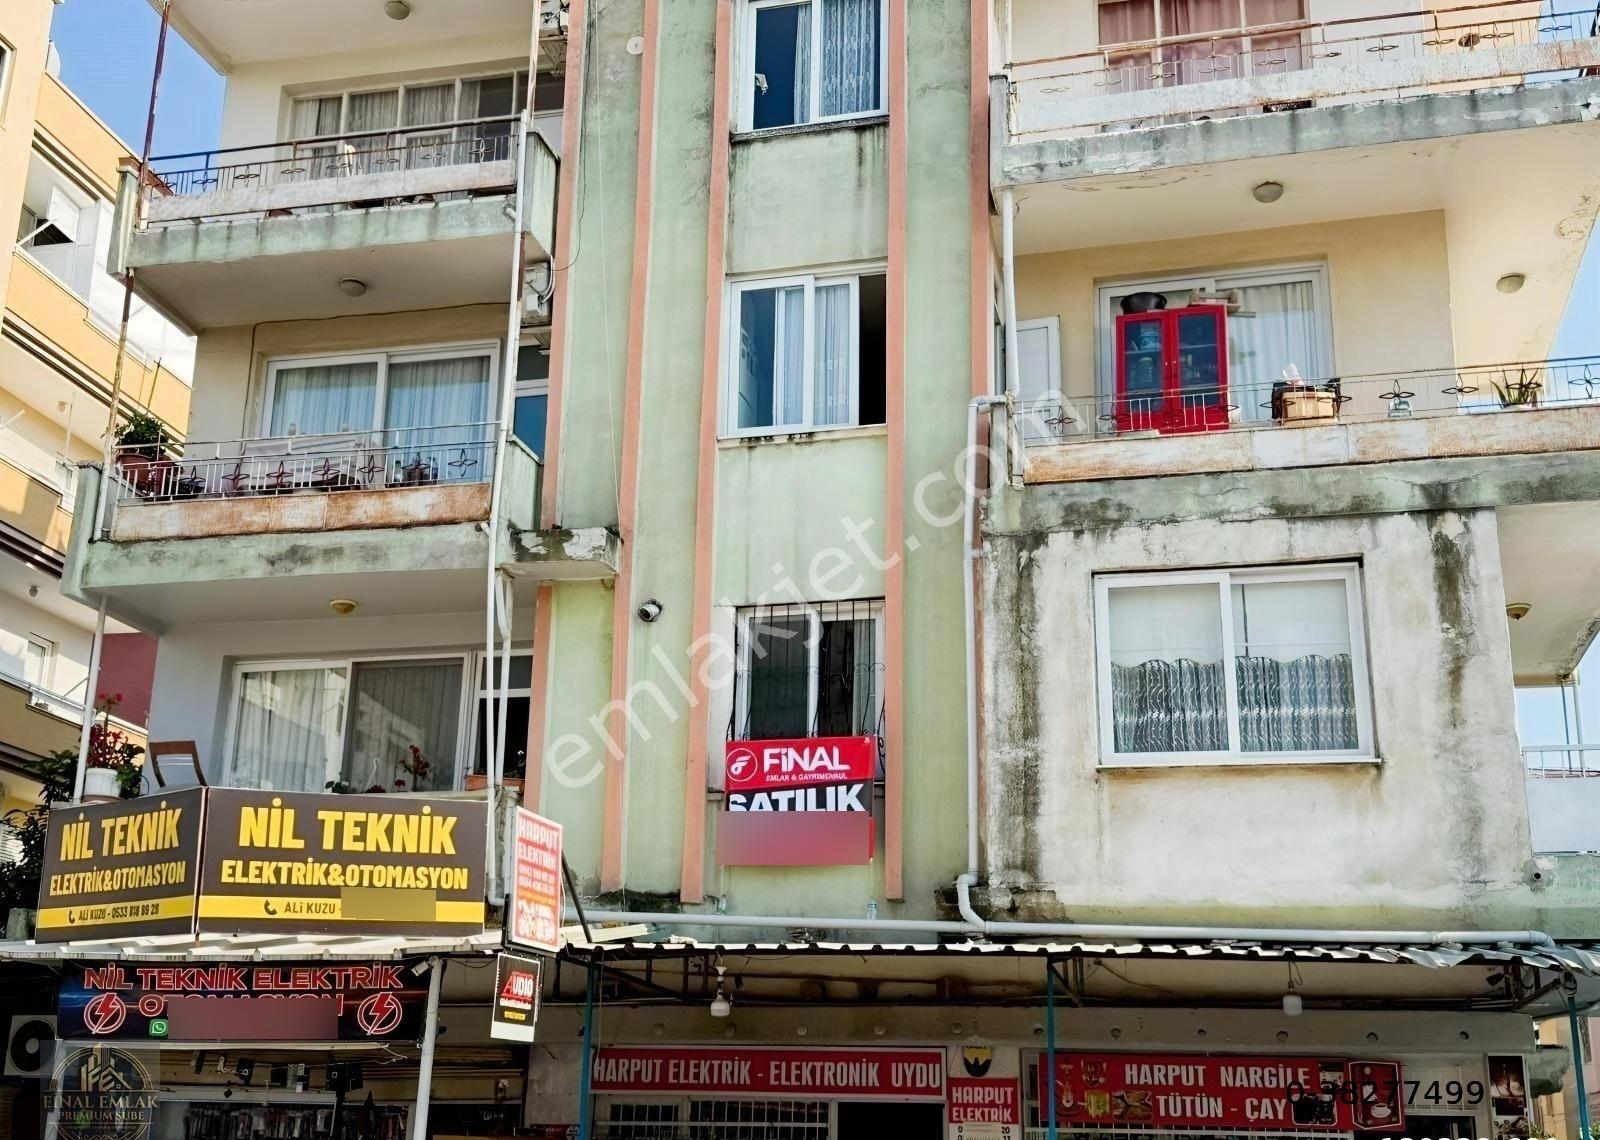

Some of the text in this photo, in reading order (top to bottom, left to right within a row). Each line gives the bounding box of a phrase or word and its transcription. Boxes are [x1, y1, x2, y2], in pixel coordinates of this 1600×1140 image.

[60, 800, 182, 861] NİL TEKNİK
[238, 797, 458, 855] NİL TEKNİK
[50, 860, 186, 896] ELEKTRİK&OTOMASYON
[221, 857, 468, 890] ELEKTRİK&OTOMASYON
[306, 902, 336, 914] KUZU
[84, 961, 404, 990] NİL TEKNİK ELEKTRİK
[501, 971, 534, 999] AUDIO
[593, 1057, 663, 1083] HARPUT
[668, 1056, 751, 1085] ELEKTRİK
[769, 1058, 880, 1088] ELEKTRONİK
[891, 1061, 941, 1088] UYDU
[1125, 1063, 1310, 1089] HARPUT NARGİLE
[952, 1086, 1014, 1104] HARPUT
[1156, 1092, 1223, 1118] TÜTÜN
[1245, 1097, 1288, 1121] ÇAY
[952, 1105, 1012, 1122] ELEKTRİK
